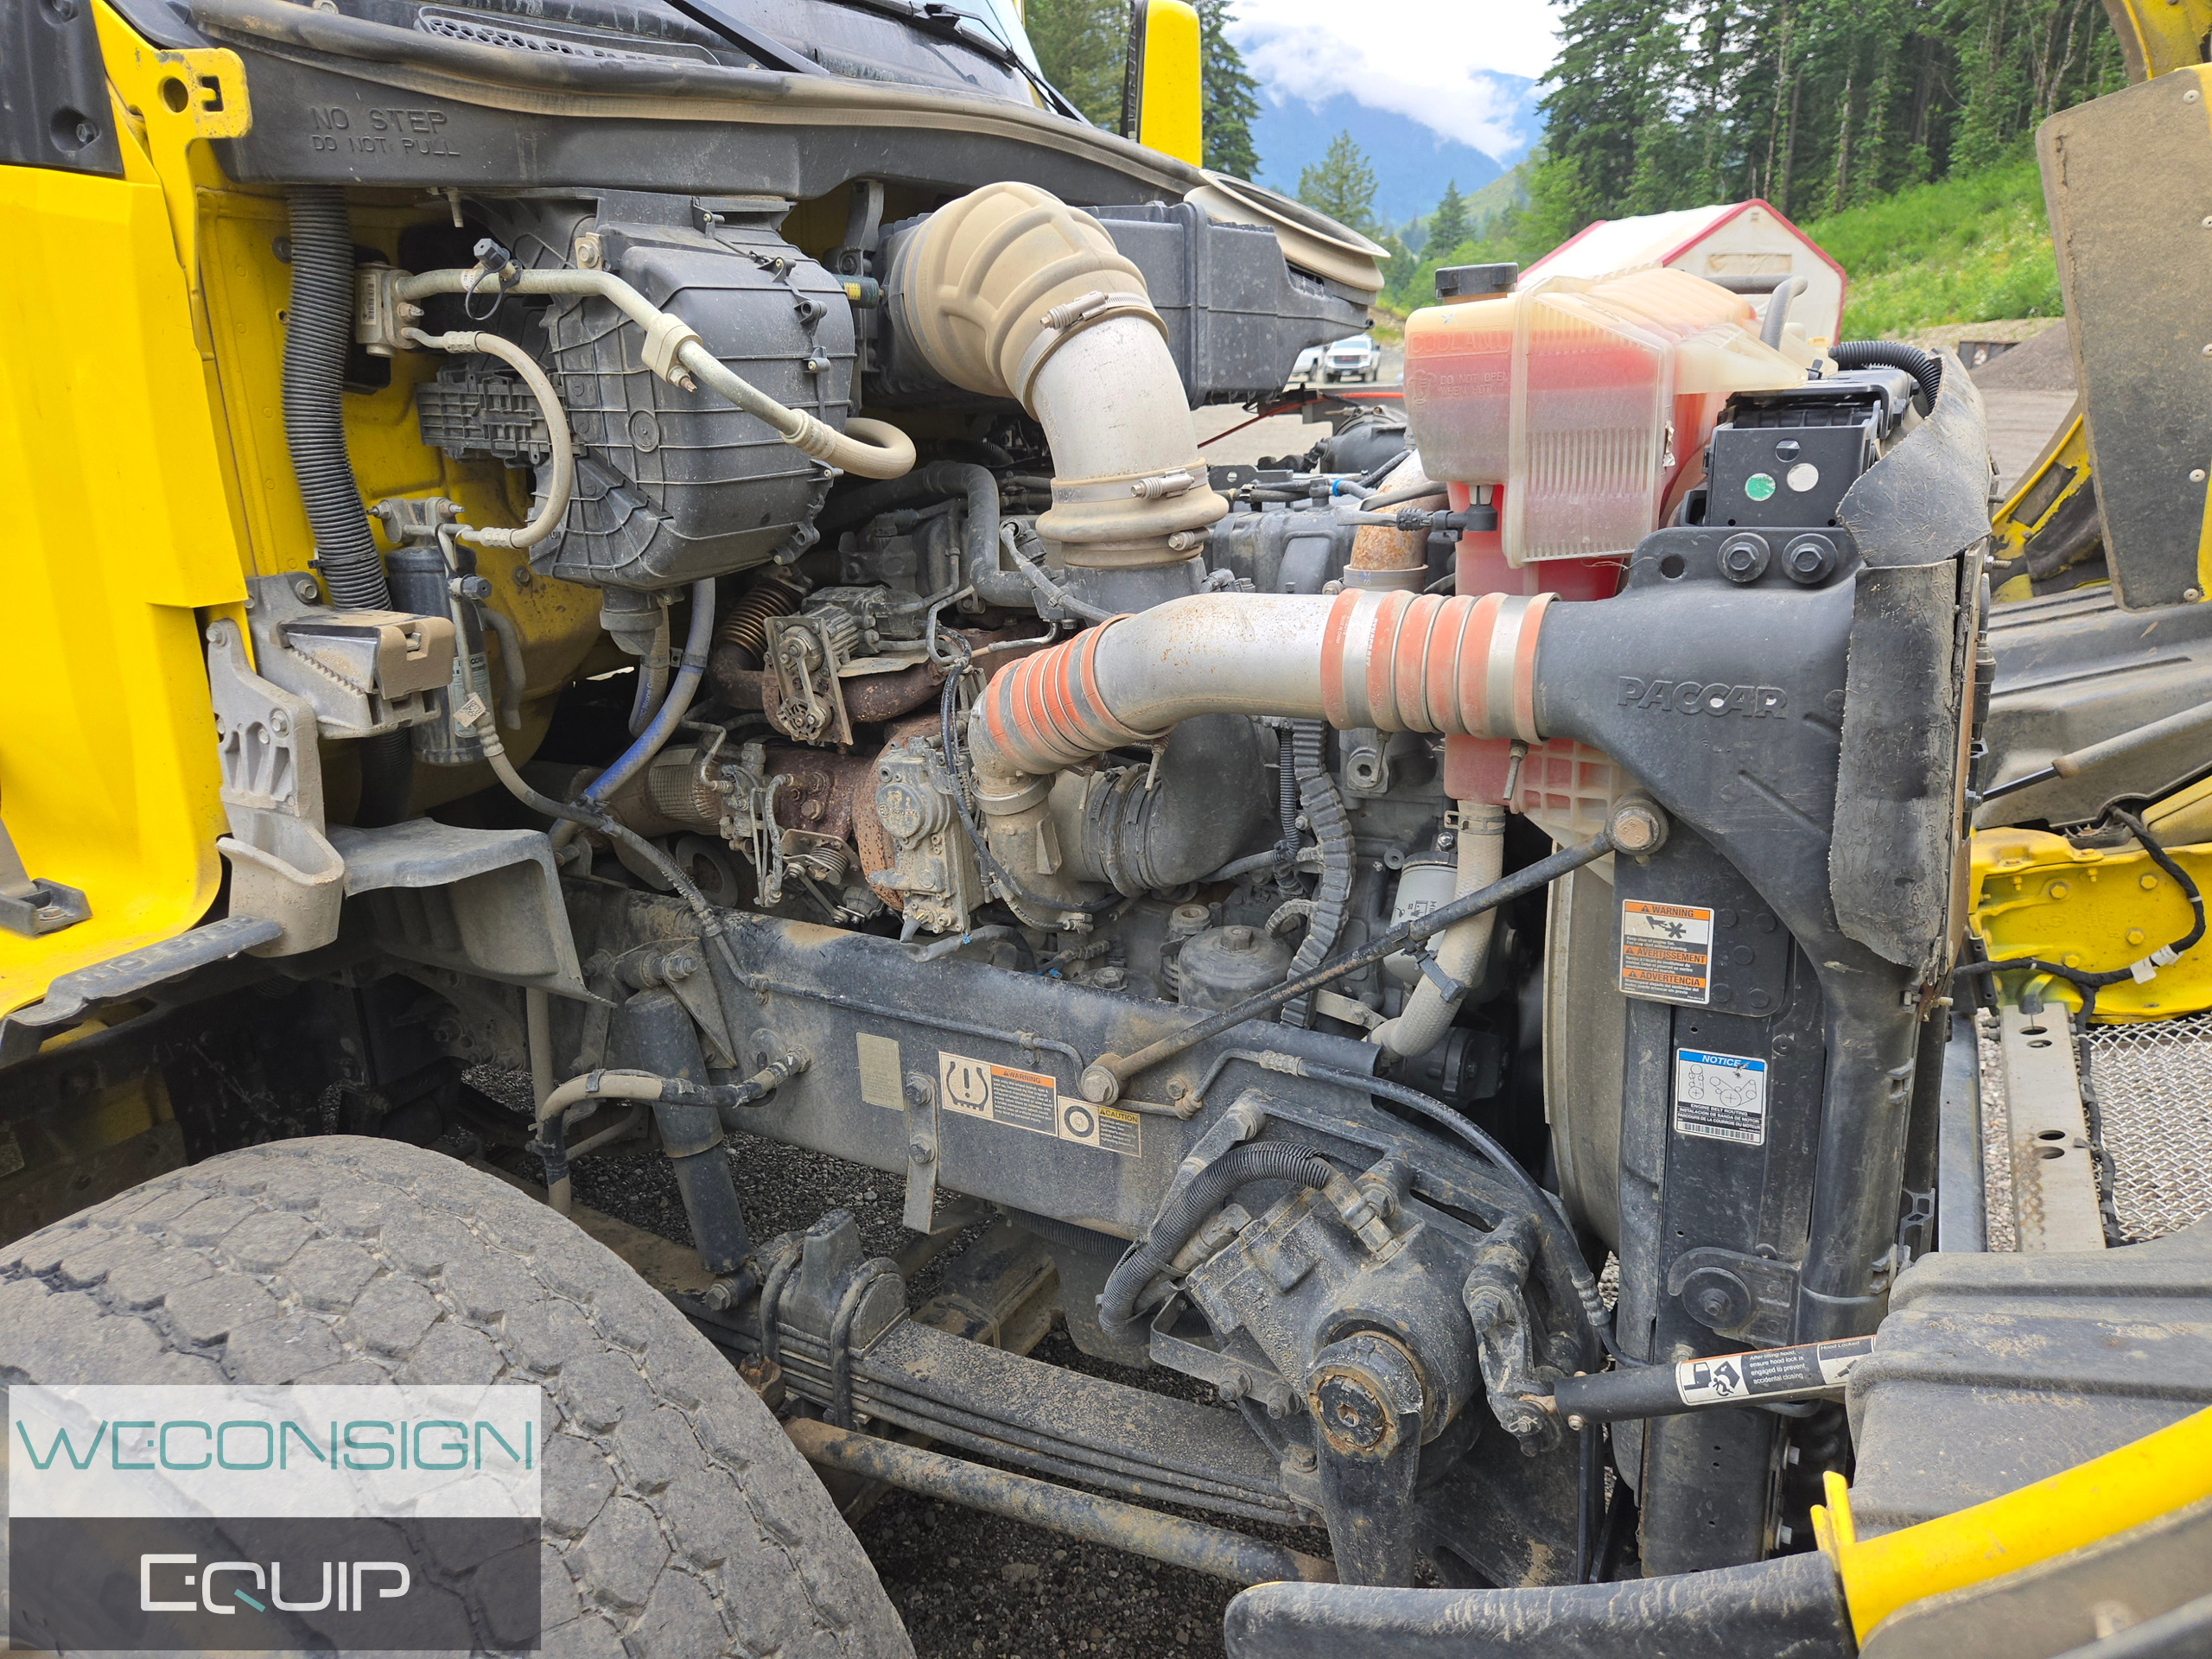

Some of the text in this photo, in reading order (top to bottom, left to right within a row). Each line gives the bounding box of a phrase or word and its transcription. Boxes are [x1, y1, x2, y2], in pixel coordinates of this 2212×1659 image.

[311, 106, 447, 134] NO STEP
[312, 135, 461, 156] DO NOT PULL
[1440, 374, 1453, 385] DO
[1459, 373, 1478, 385] NOT
[1438, 386, 1466, 397] WHEN
[1618, 676, 1788, 719] PACCAR
[1651, 906, 1694, 918] WARNING
[1637, 948, 1706, 963] AVERTISSEMENT
[1639, 971, 1700, 986] ADVERTENCIA
[1701, 1054, 1742, 1067] NOTICE
[1010, 1071, 1041, 1084] WARNING
[1106, 1109, 1138, 1122] CAUTION
[1764, 1351, 1779, 1360] tilting
[1749, 1359, 1770, 1368] ensure
[1770, 1357, 1784, 1366] hood
[1751, 1367, 1776, 1376] engaged
[1783, 1363, 1806, 1373] prevent
[1753, 1372, 1803, 1384] accidental closing
